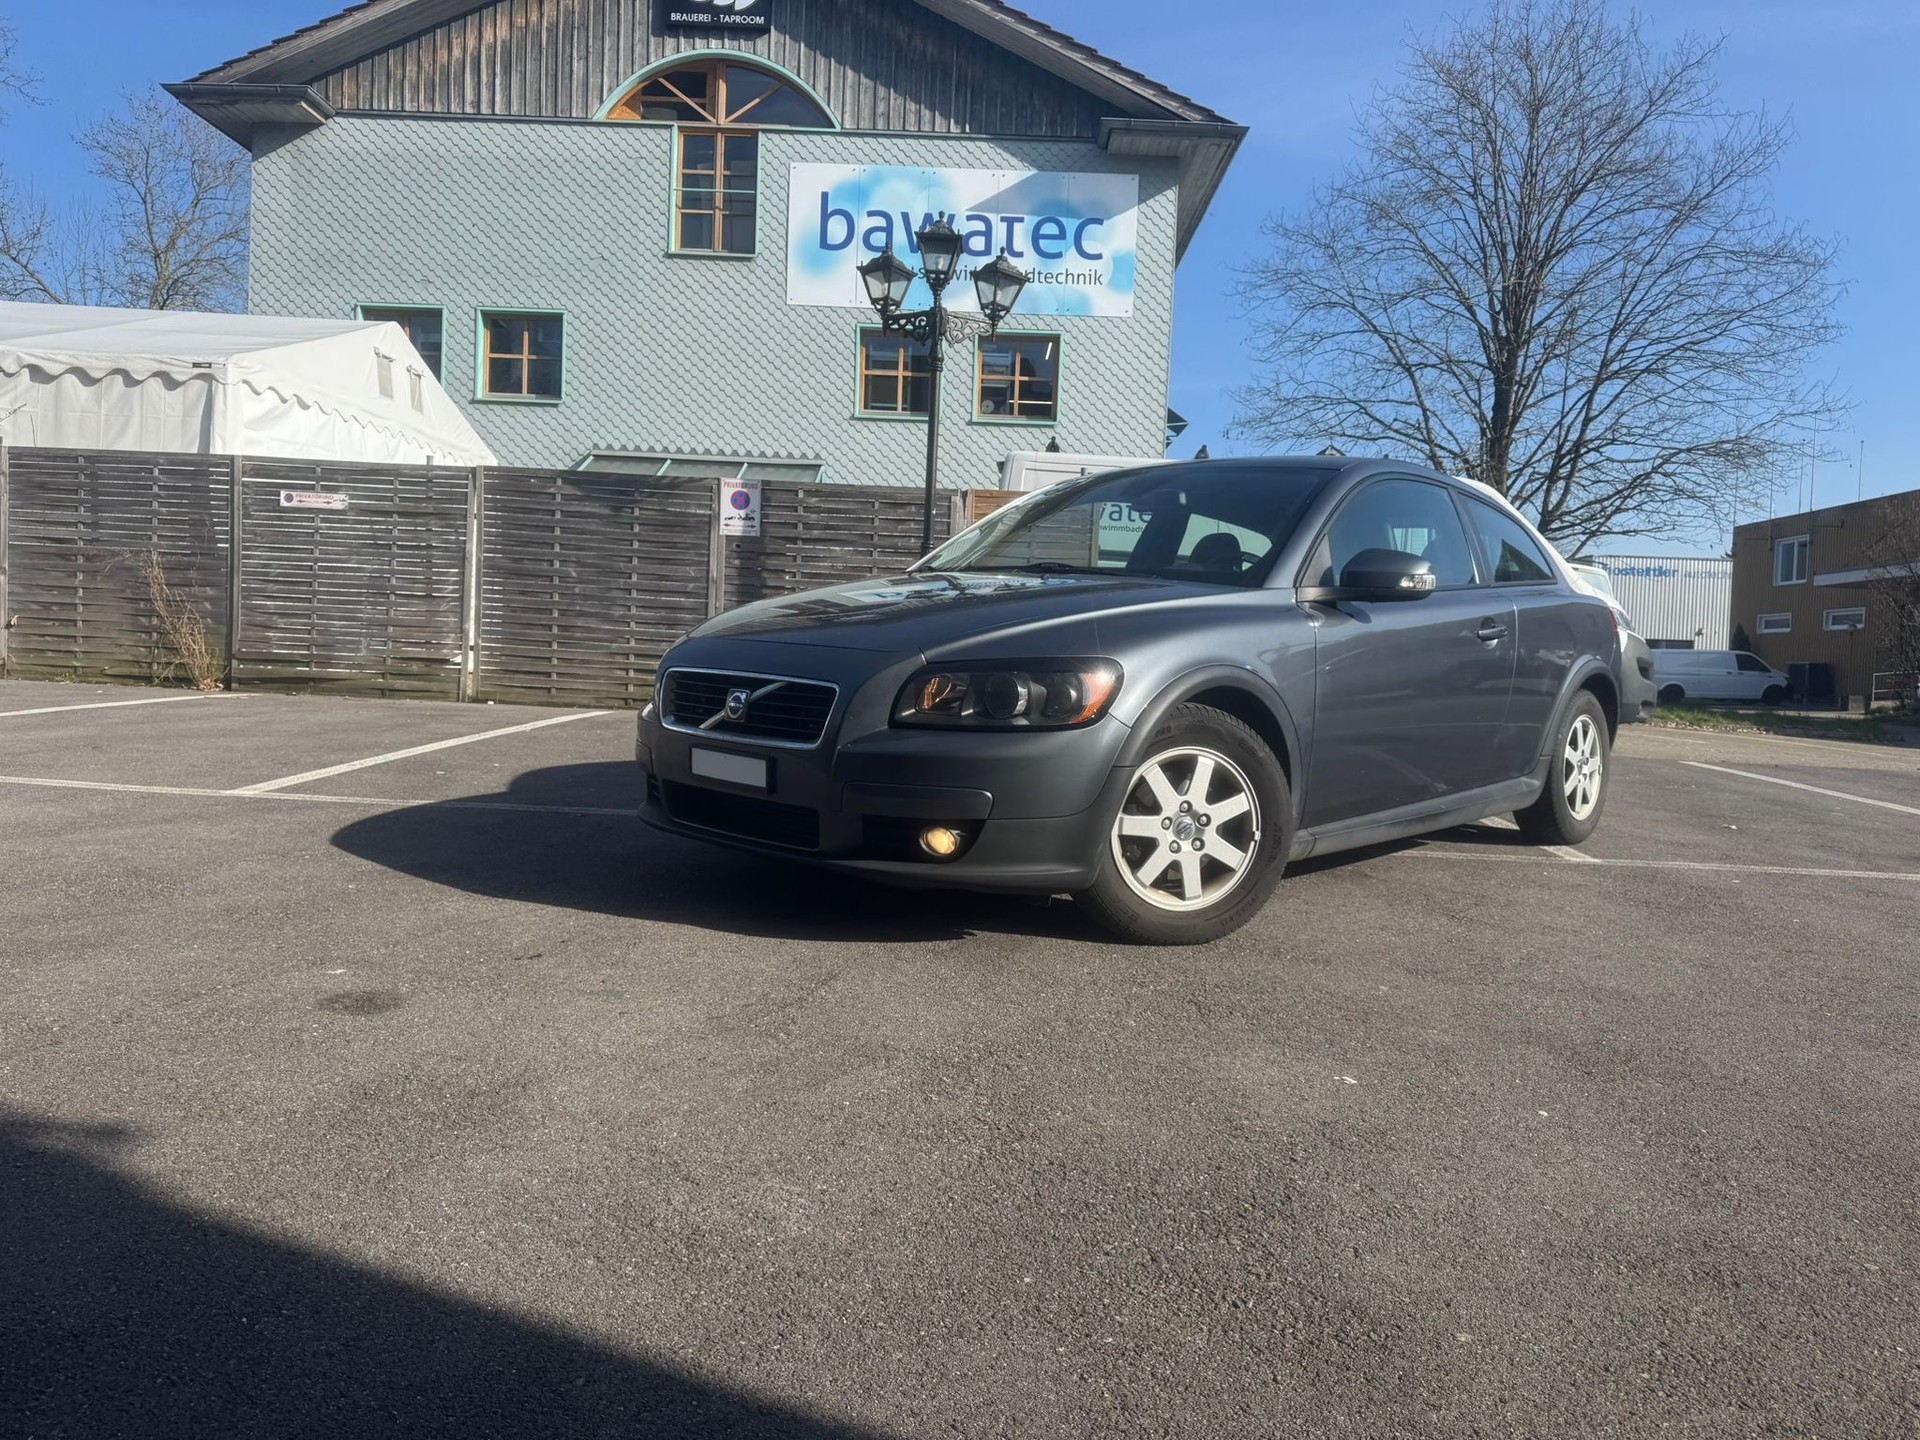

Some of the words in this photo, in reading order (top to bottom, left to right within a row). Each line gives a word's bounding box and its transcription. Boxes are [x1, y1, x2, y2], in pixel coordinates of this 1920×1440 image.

[670, 12, 711, 22] BRAUEREI
[720, 14, 764, 24] TAPROOM
[819, 191, 1104, 260] bawatec
